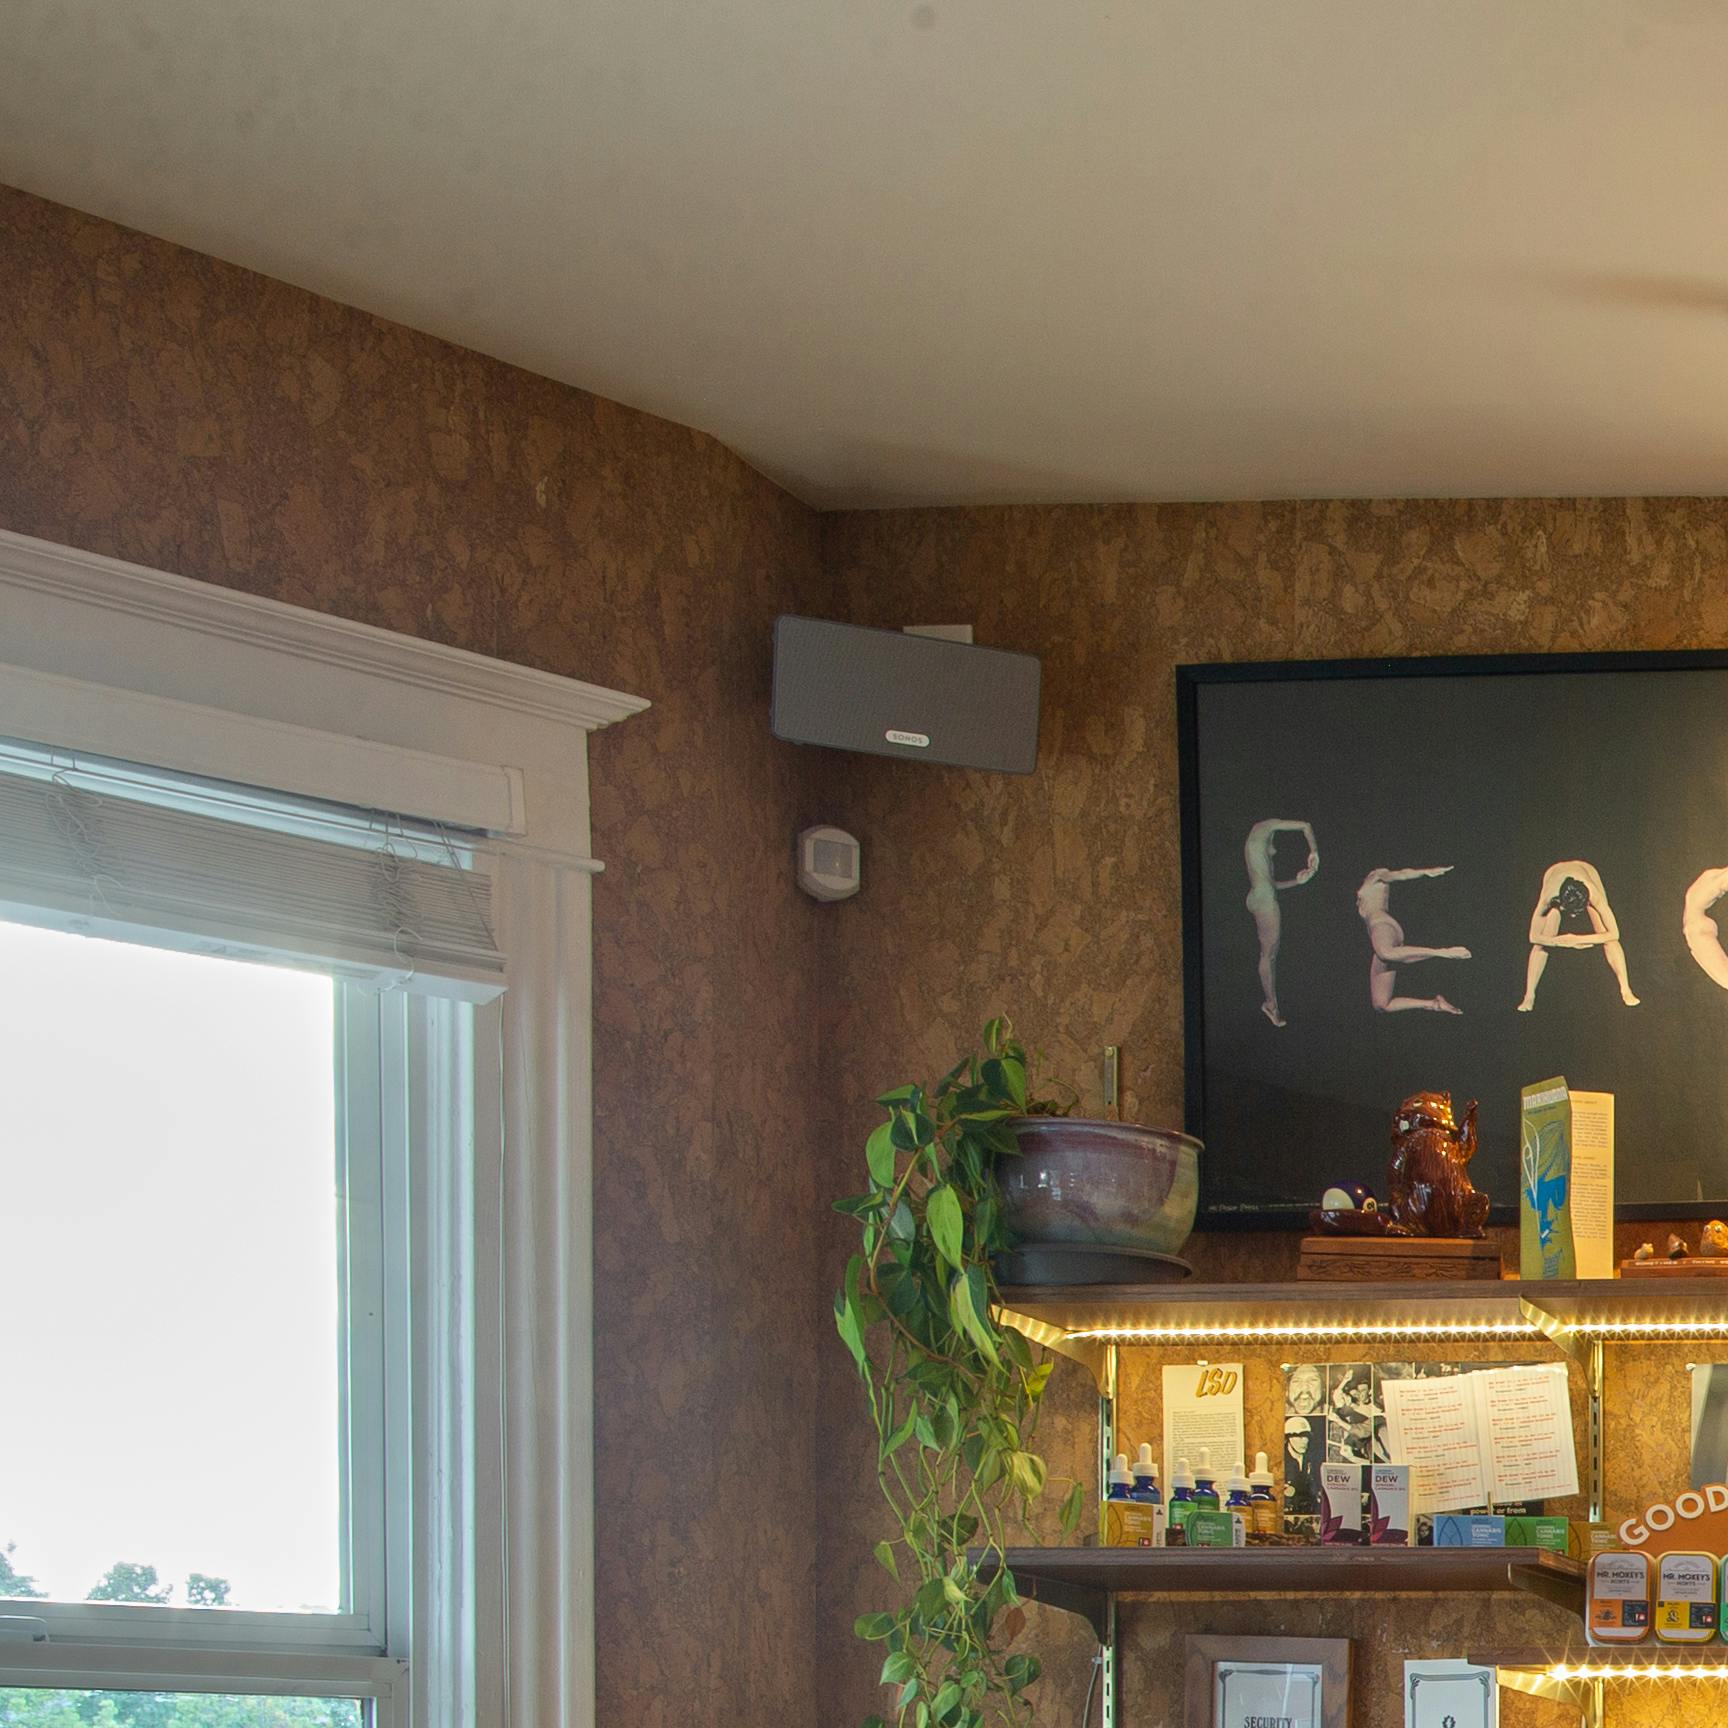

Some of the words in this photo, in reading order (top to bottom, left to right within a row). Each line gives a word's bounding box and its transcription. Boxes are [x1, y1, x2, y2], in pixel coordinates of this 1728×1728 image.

[892, 733, 923, 744] SONOS
[1196, 1368, 1238, 1399] LSD
[1326, 1475, 1351, 1484] DEW
[1375, 1475, 1398, 1483] DEW
